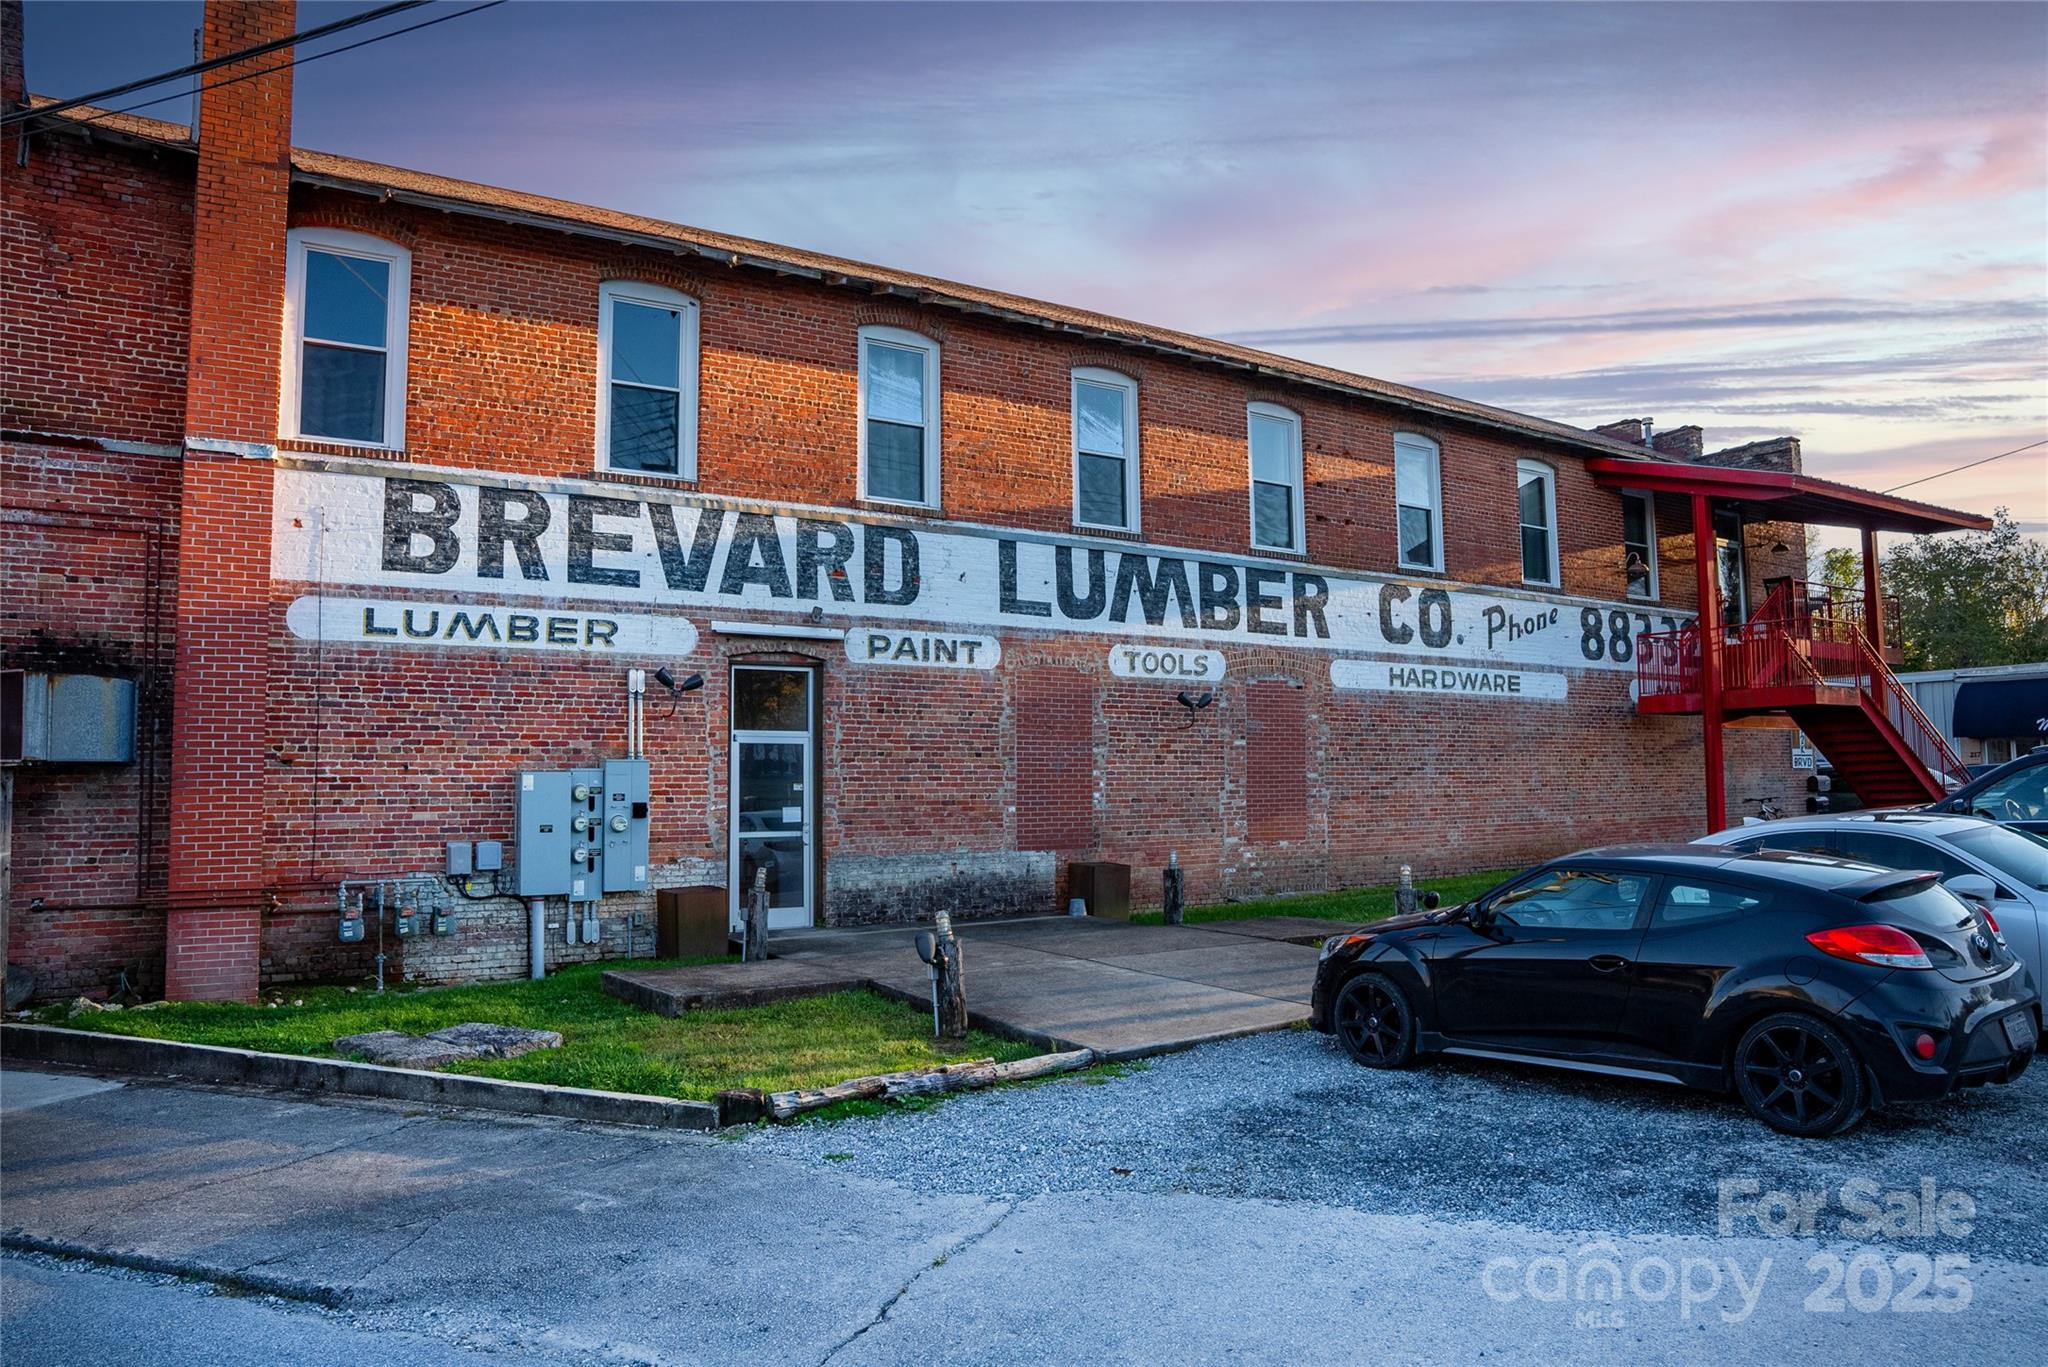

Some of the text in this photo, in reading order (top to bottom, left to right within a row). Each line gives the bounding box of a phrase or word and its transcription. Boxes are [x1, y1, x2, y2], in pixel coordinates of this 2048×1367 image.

[381, 477, 920, 605] BREVARD
[999, 539, 1330, 639] LUMBER
[1379, 583, 1464, 649] CO.
[1482, 604, 1558, 650] Phone
[363, 607, 619, 648] LUMBER
[867, 634, 982, 664] PAINT
[1123, 651, 1208, 676] TOOLS
[1389, 667, 1521, 693] HARDWARE
